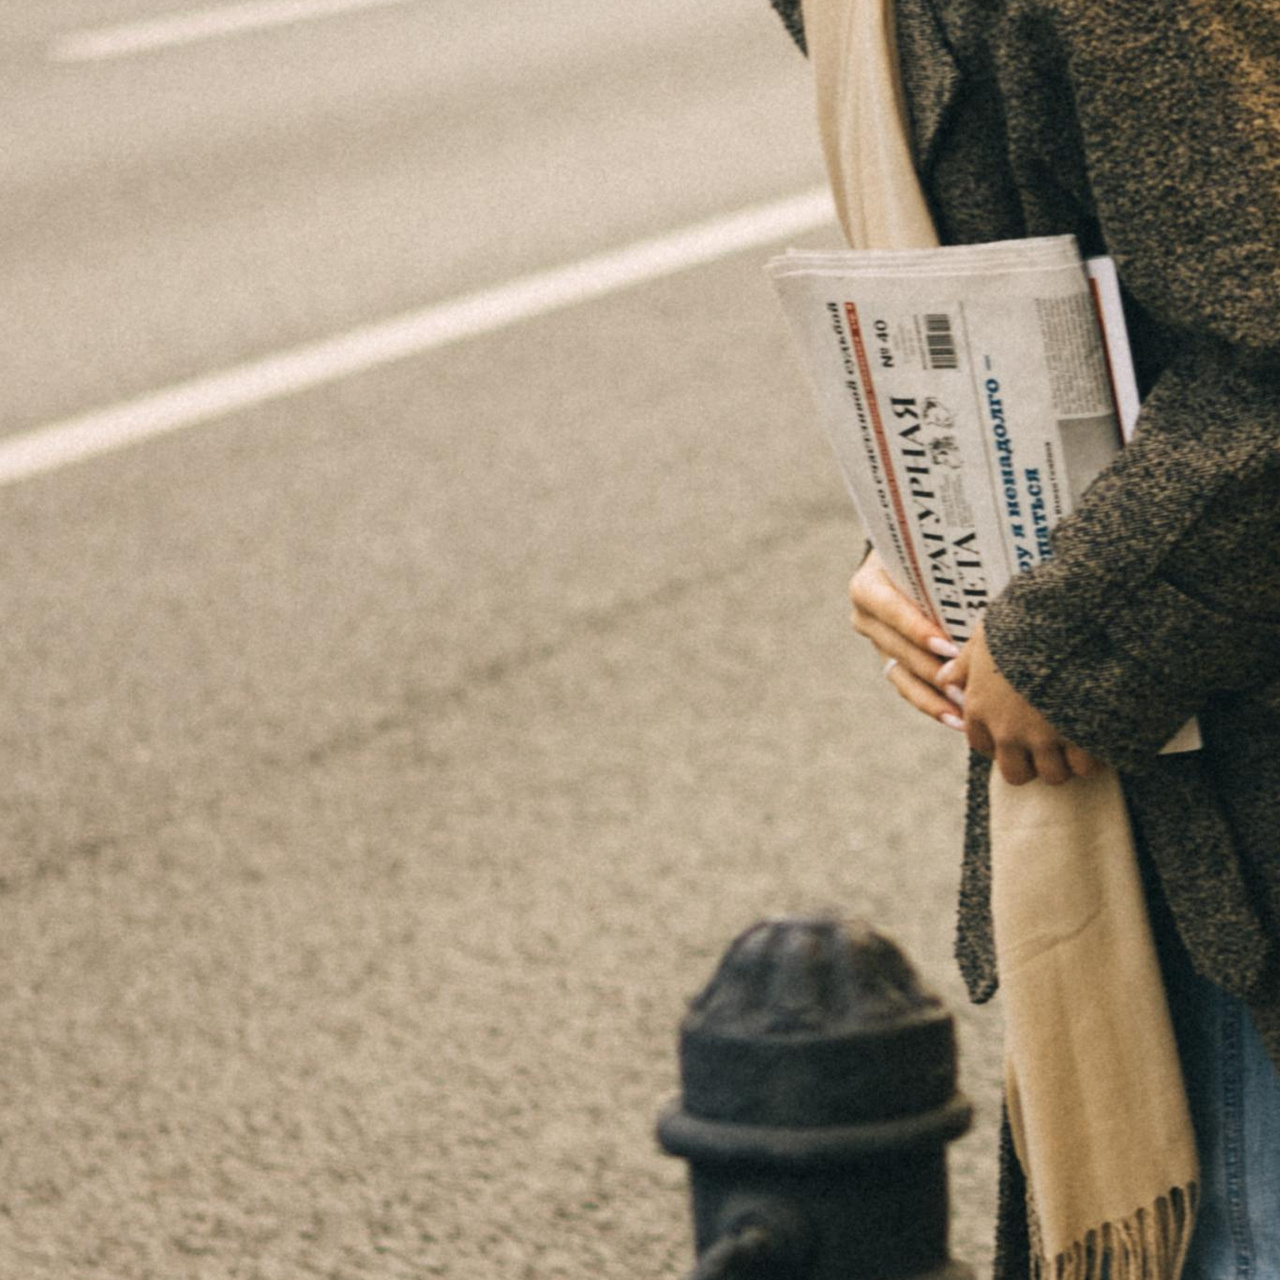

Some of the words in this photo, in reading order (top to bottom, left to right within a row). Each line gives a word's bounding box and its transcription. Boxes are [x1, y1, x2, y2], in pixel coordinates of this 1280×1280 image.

[827, 302, 854, 375] судьбой
[874, 319, 889, 342] 40
[985, 378, 1021, 517] ненадолго
[1011, 523, 1025, 538] я
[1024, 468, 1053, 561] паться
[953, 532, 988, 618] ЗЕТА
